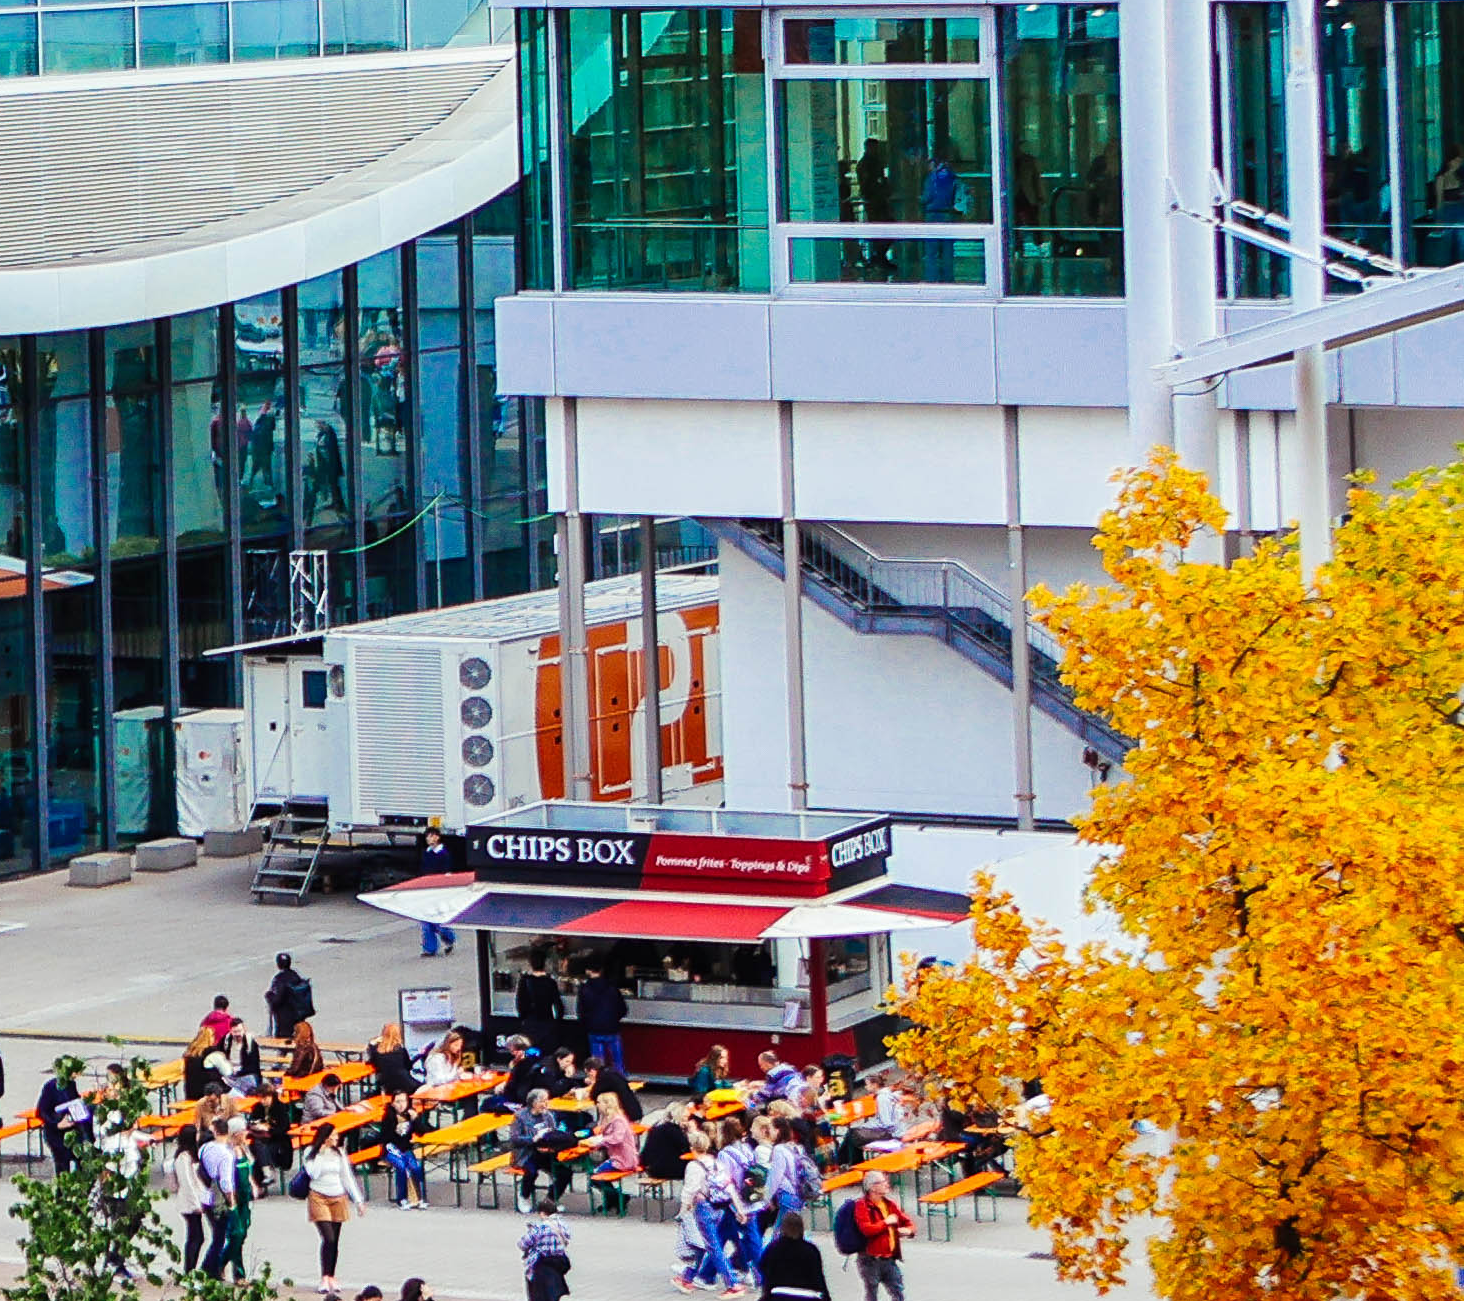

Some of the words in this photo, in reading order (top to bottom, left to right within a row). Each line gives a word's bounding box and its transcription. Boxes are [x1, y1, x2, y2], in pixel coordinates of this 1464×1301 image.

[485, 833, 573, 862] CHIPS
[575, 837, 636, 866] BOX
[831, 834, 864, 868] CHIPS
[863, 826, 888, 857] BOX
[655, 854, 697, 868] Pommes
[730, 857, 775, 874] Toppings
[776, 860, 786, 872] &
